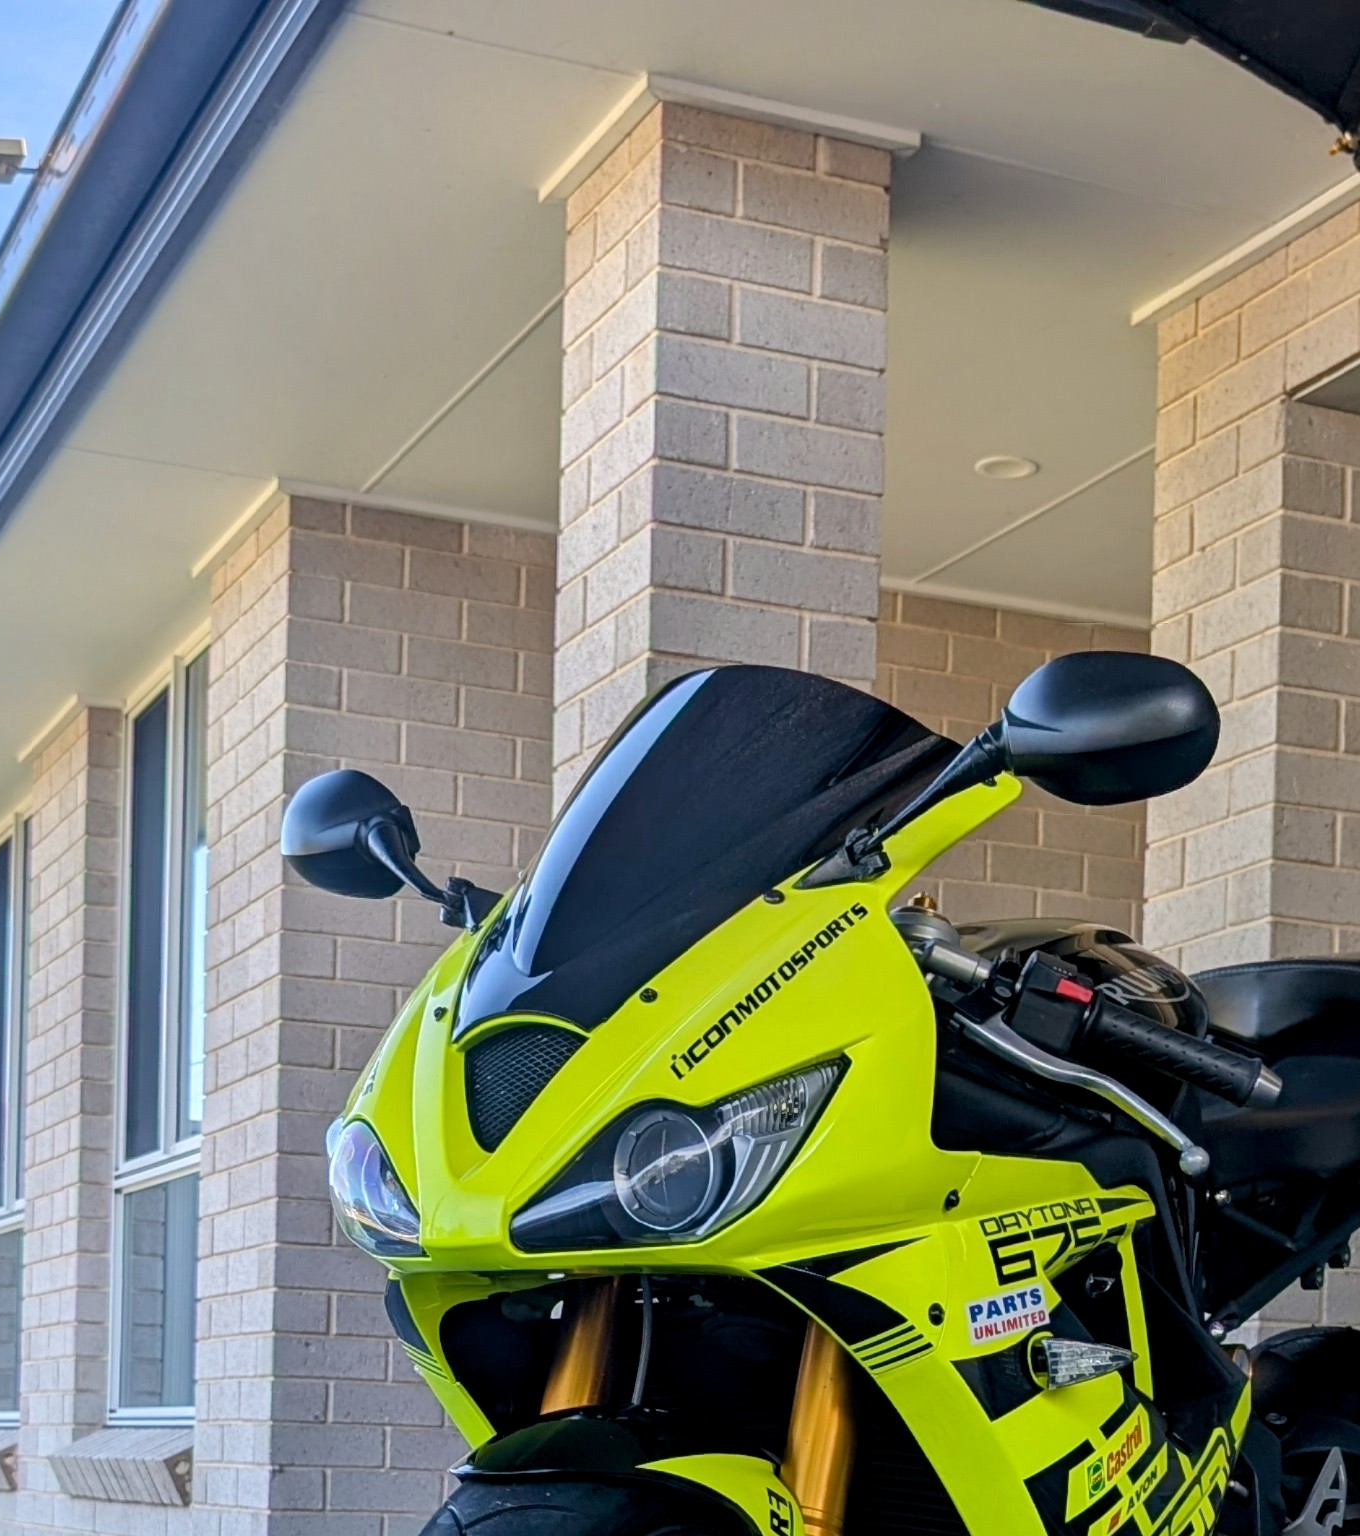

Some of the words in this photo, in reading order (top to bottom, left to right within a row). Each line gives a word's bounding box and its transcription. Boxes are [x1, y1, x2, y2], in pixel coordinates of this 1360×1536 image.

[978, 1197, 1096, 1237] DAYTONA
[987, 1216, 1102, 1287] 675
[968, 1287, 1043, 1324] PARTS
[973, 1309, 1047, 1341] UNLIMITED
[1106, 1415, 1143, 1482] Castrol
[1126, 1465, 1159, 1517] AVON
